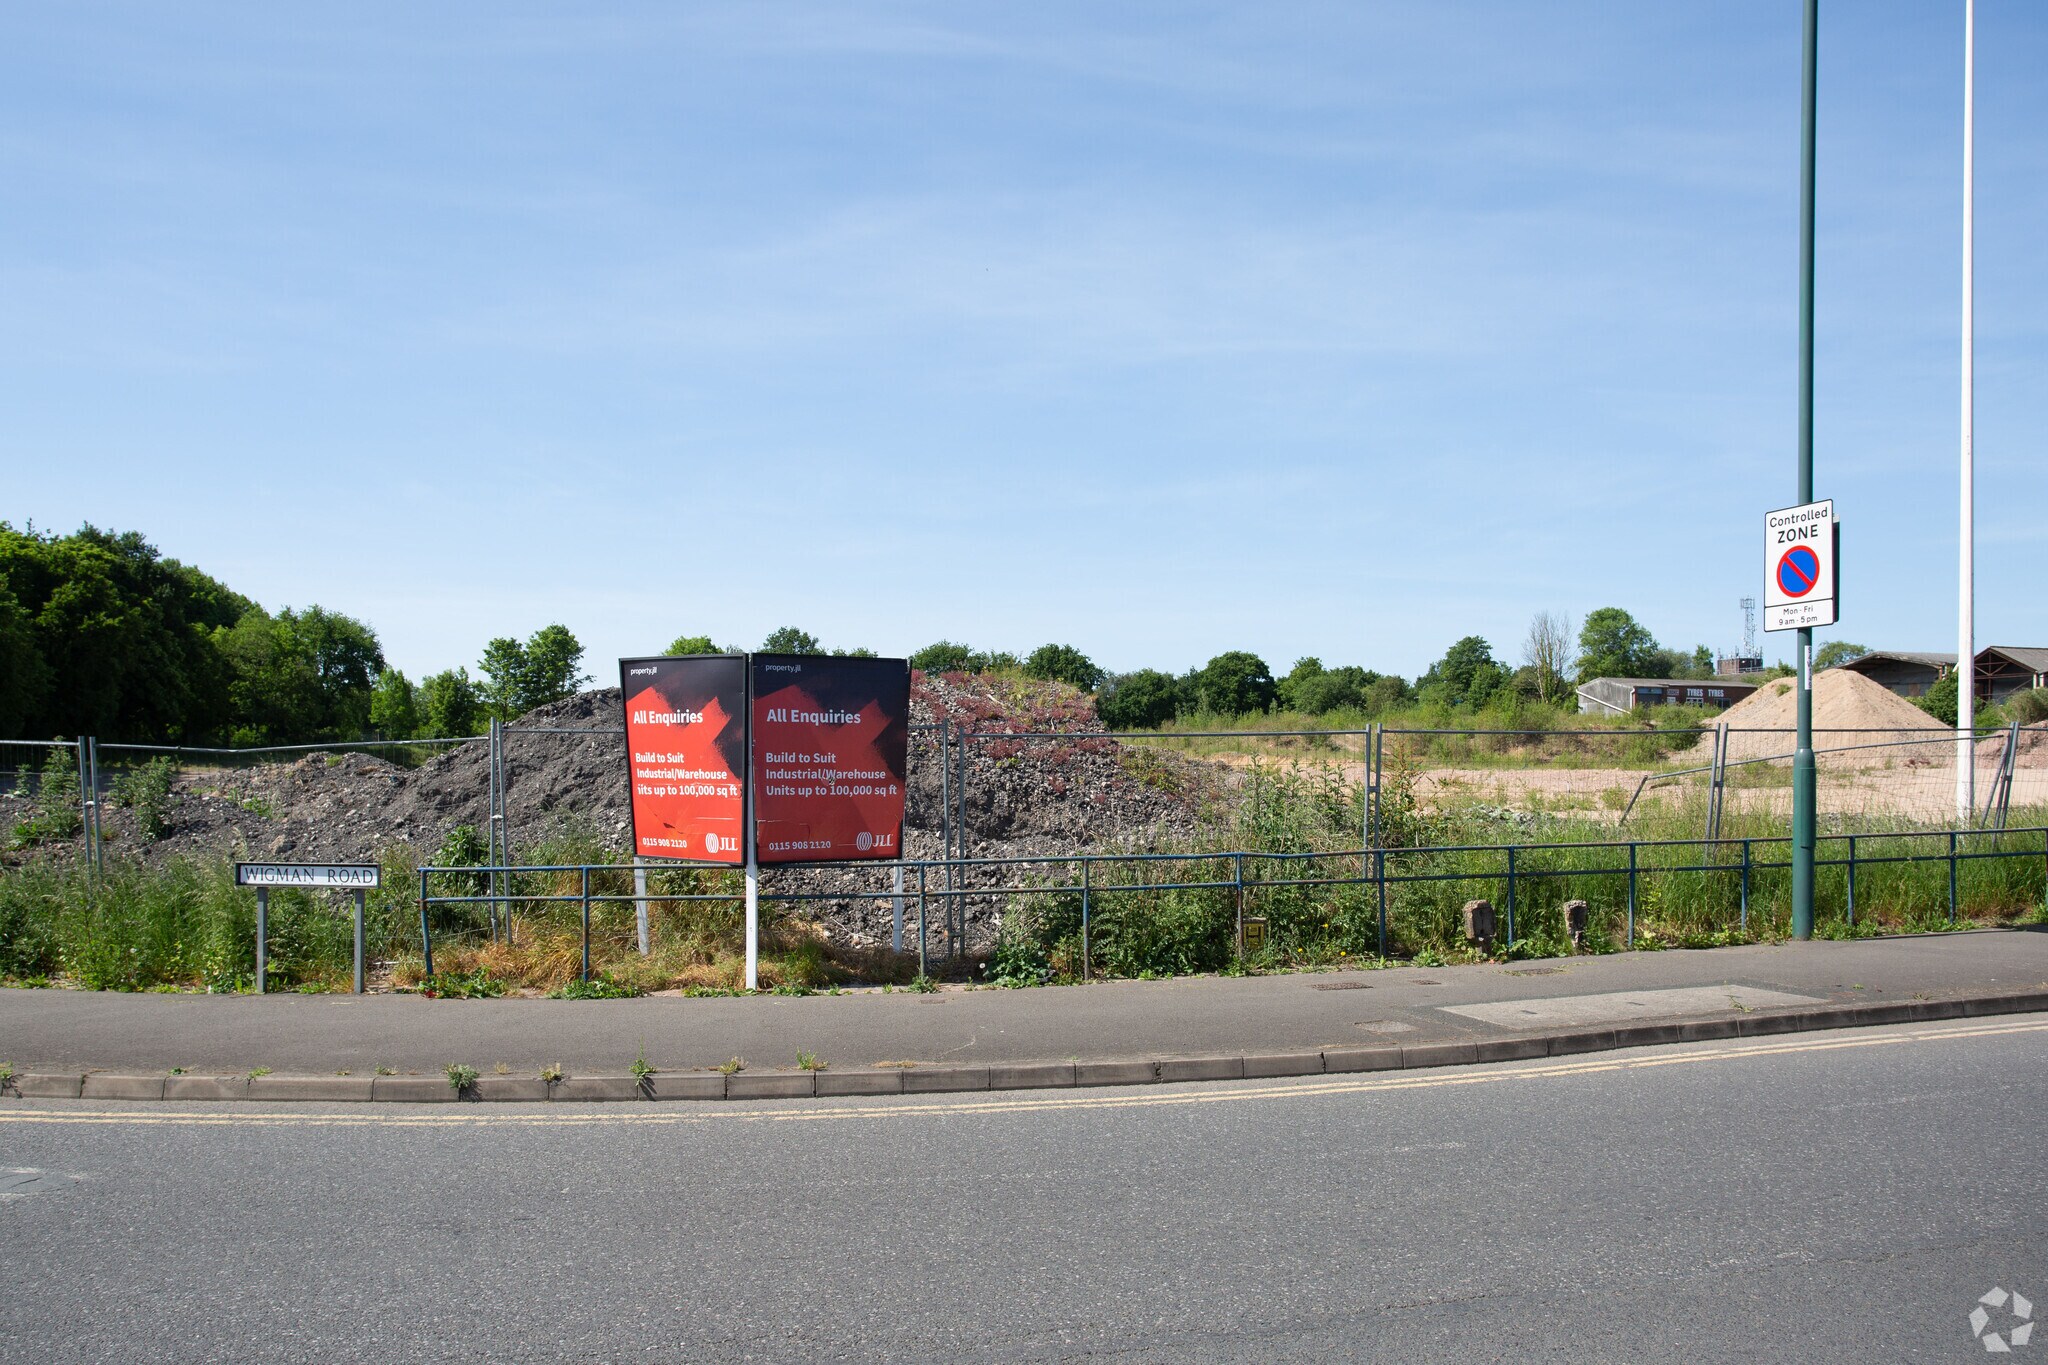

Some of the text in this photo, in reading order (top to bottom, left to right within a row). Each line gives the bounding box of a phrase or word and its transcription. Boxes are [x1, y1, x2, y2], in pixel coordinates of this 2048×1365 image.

[1769, 506, 1828, 528] Controlled
[1777, 524, 1818, 543] ZONE
[1803, 605, 1814, 613] Fri
[1800, 616, 1806, 624] 5
[1806, 616, 1818, 624] pm
[1687, 688, 1704, 697] TYRES
[1708, 689, 1724, 697] TYRES
[633, 709, 703, 726] All Enquiries
[767, 709, 861, 726] All Enquiries
[635, 752, 685, 763] Build to Suit
[766, 752, 836, 763] Build to Suit
[636, 768, 728, 780] Industrial/Warehouse
[766, 769, 886, 780] Industrial/Warehouse
[654, 786, 666, 797] up
[667, 786, 678, 795] to
[679, 785, 715, 797] 100,000
[716, 788, 728, 798] sq
[729, 785, 738, 796] ft
[766, 785, 898, 797] Units up to 100,000 sq ft
[642, 837, 658, 846] 0115
[671, 839, 688, 848] 2120
[719, 837, 738, 851] JLL
[768, 840, 832, 851] 0115 908 2120
[872, 833, 894, 847] JLL
[244, 867, 374, 884] WIGMAN ROAD
